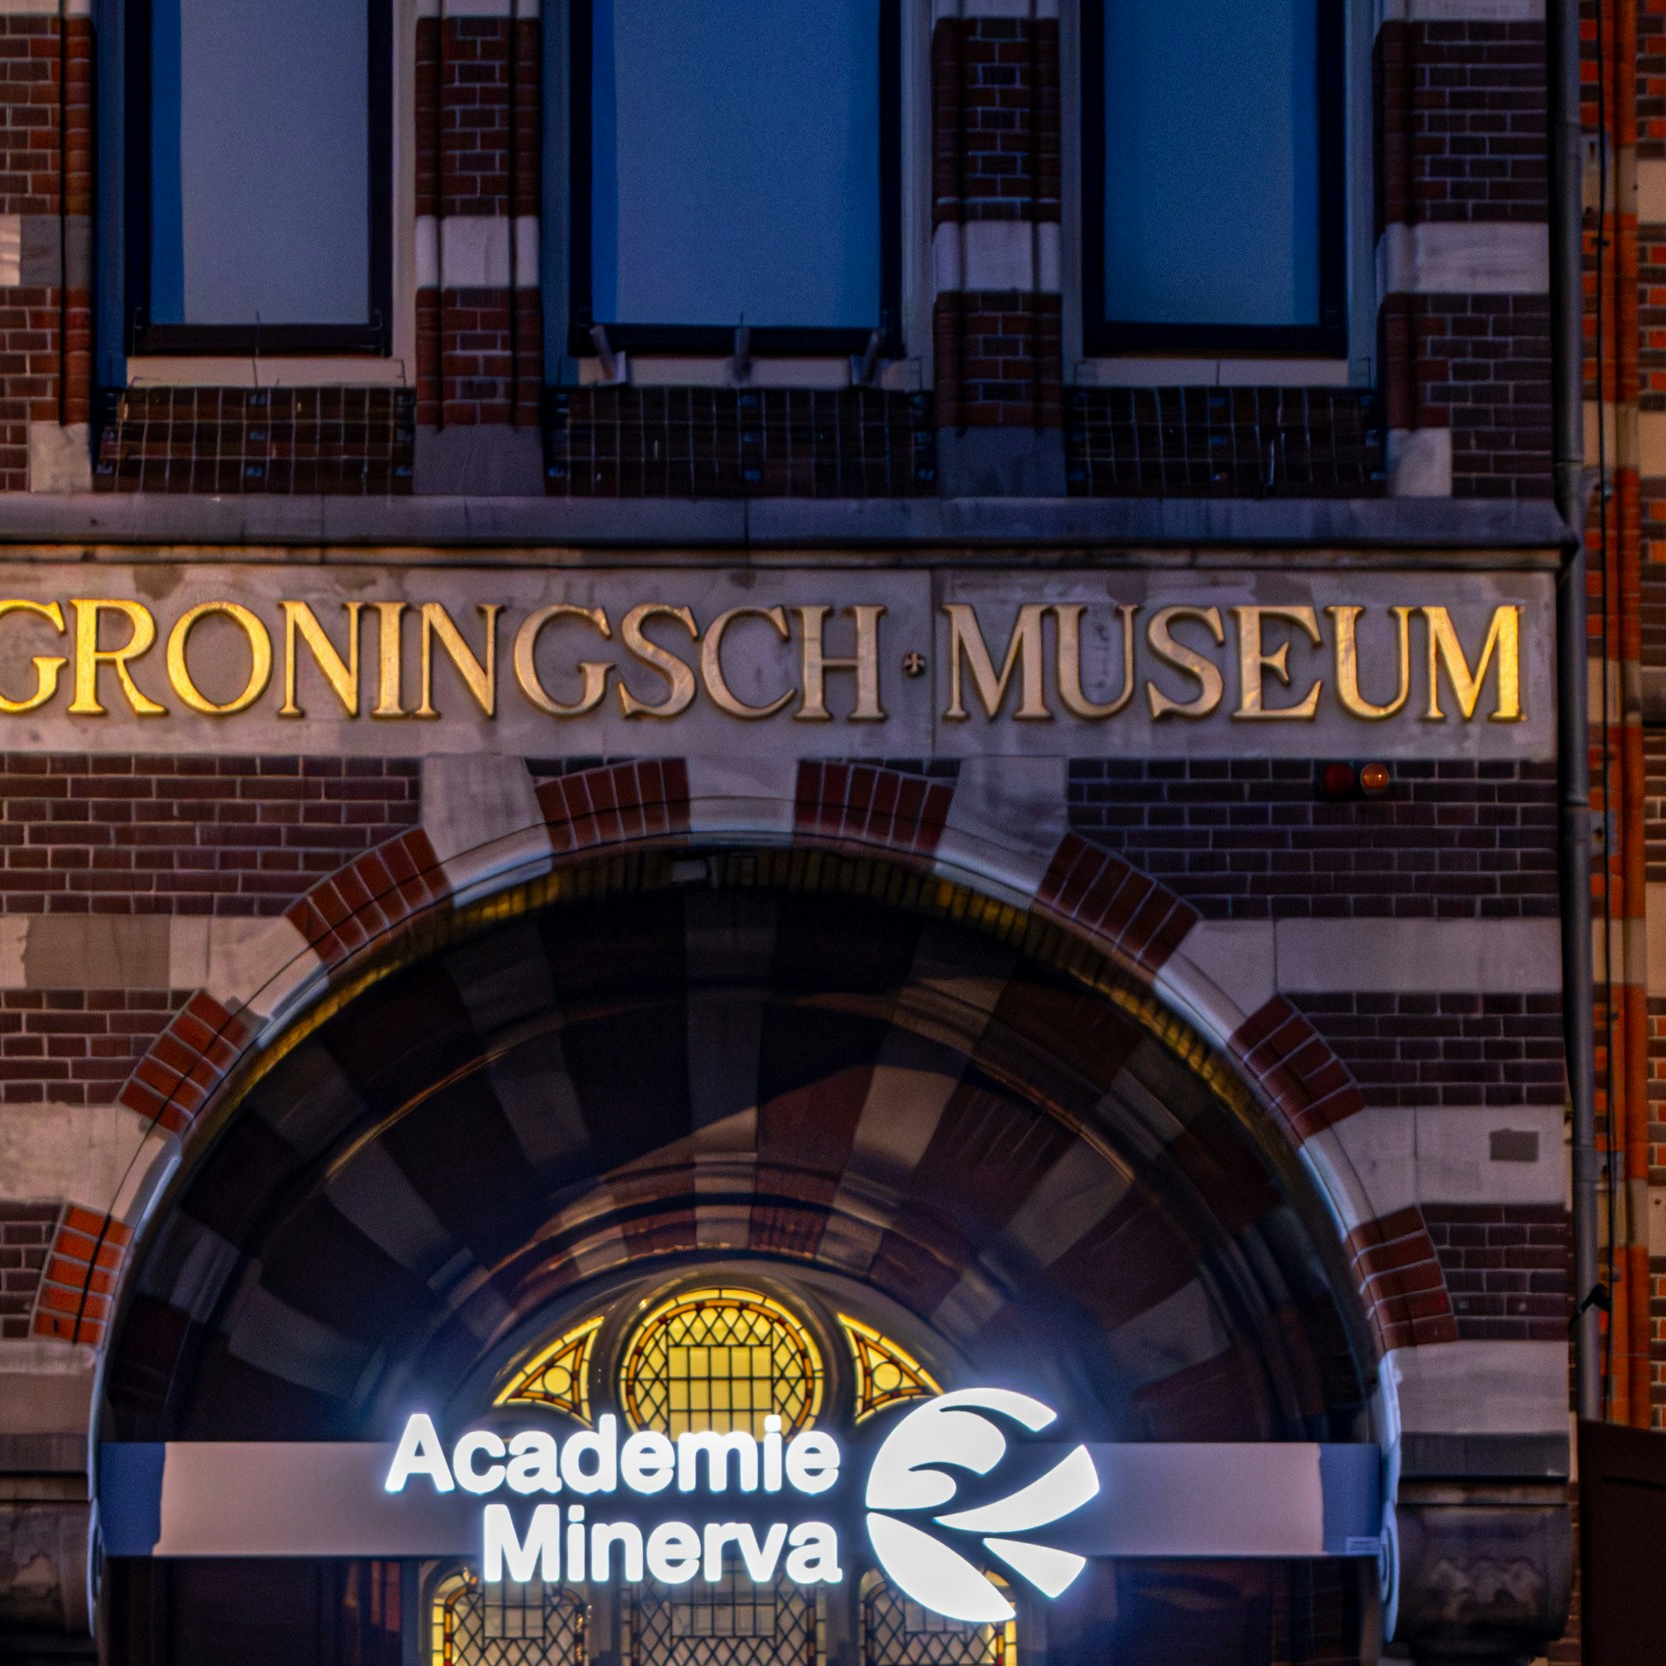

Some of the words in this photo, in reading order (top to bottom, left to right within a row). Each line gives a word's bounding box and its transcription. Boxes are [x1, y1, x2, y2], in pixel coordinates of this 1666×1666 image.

[941, 602, 1528, 722] MUSEUM
[384, 1412, 842, 1494] Academie
[483, 1503, 844, 1585] Minerva
